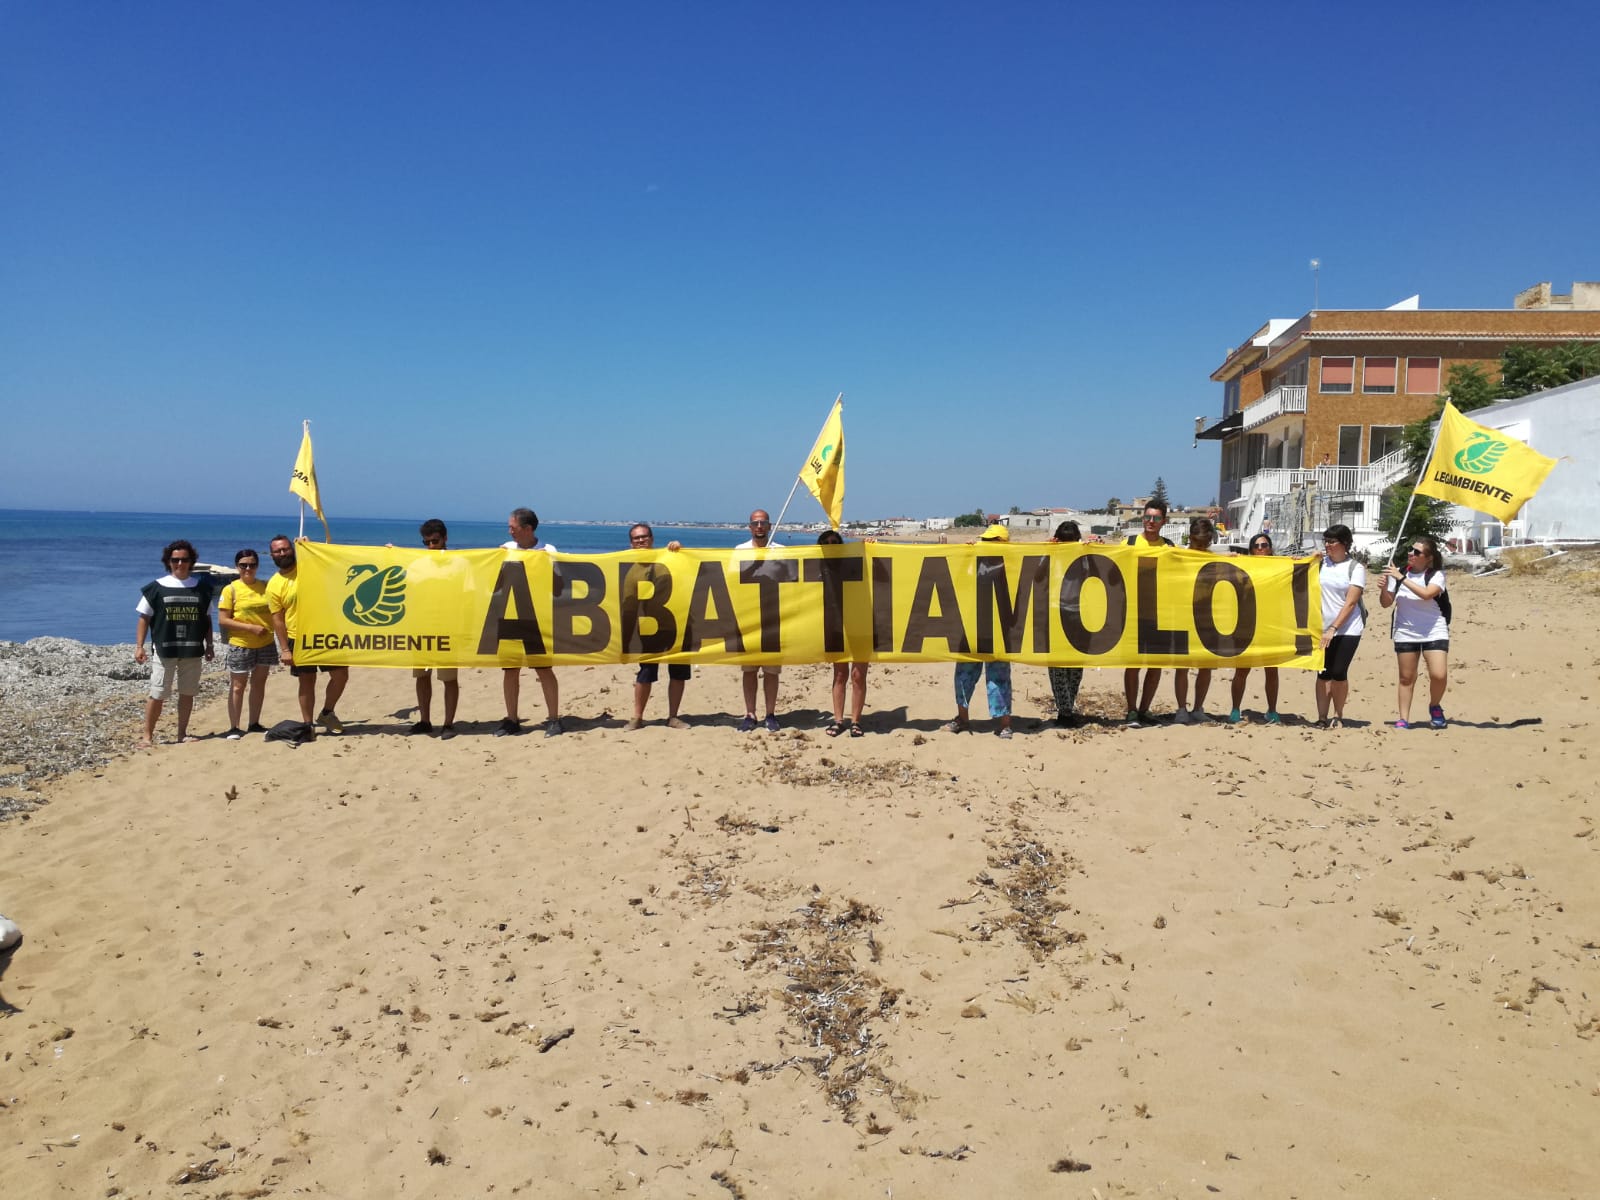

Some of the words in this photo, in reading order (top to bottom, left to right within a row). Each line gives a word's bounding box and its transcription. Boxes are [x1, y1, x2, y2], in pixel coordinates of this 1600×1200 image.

[1434, 470, 1514, 504] LEGAMBIENTE
[476, 552, 1257, 658] ABBATTIAMOLO
[301, 633, 451, 652] LEGAMBIENTE
